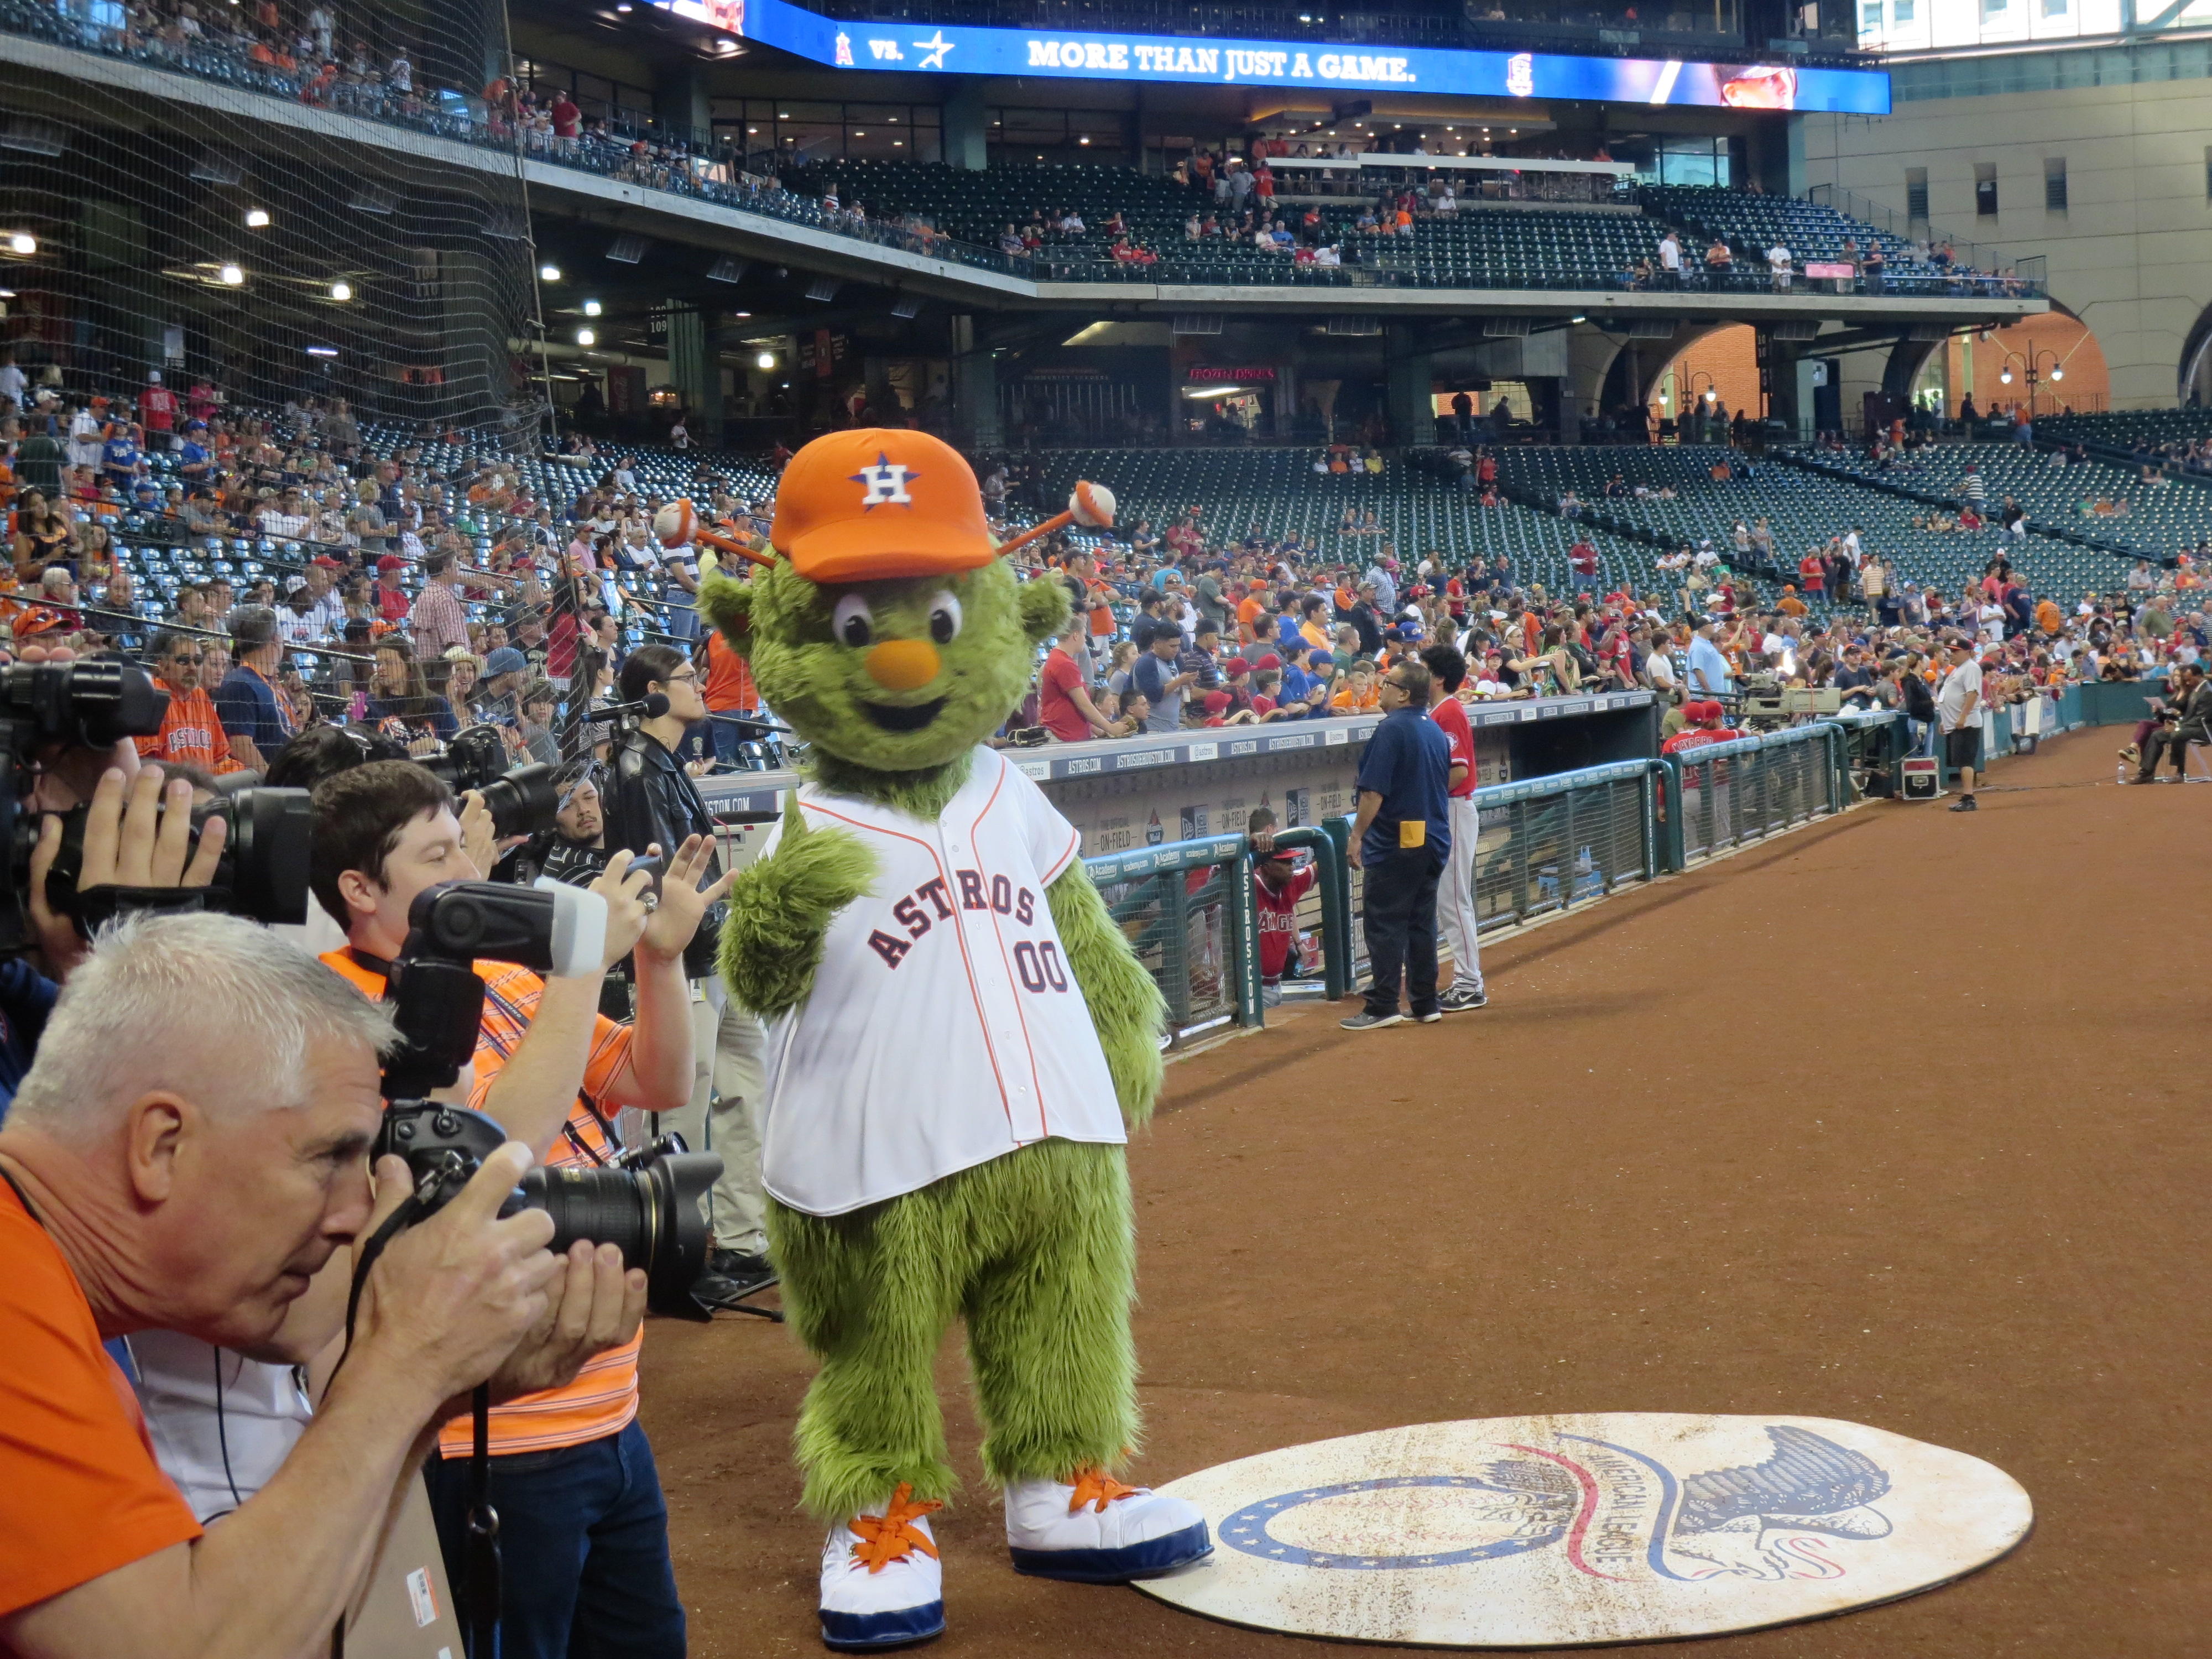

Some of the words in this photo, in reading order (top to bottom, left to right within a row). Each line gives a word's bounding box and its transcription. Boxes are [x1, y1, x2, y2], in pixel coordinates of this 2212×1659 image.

[1027, 40, 1129, 69] MORE
[1135, 46, 1219, 73] THAN
[1224, 50, 1287, 80] JUST
[1291, 53, 1313, 77] A
[1317, 54, 1416, 82] GAME.
[651, 321, 667, 333] 109
[1191, 369, 1232, 379] FROZEN
[1235, 369, 1275, 379] DRINKS
[859, 465, 911, 504] H
[1068, 757, 1102, 774] ASTROS.COM
[1194, 745, 1213, 759] @astros
[1231, 740, 1257, 755] ASTROS.COM
[1222, 810, 1246, 828] ON-FIELD
[1320, 793, 1342, 811] ON-FIELD
[1100, 830, 1131, 851] ON-FIELD
[1095, 863, 1117, 876] Academy
[1160, 849, 1180, 863] Academy
[1219, 842, 1238, 855] Academy
[868, 869, 1035, 971] ASTROS
[1258, 907, 1293, 933] ANGE
[1014, 941, 1068, 994] 00
[491, 990, 521, 1018] SAMSUNG
[1587, 1454, 1647, 1510] AMERICAN
[1596, 1514, 1641, 1563] LEAGUE
